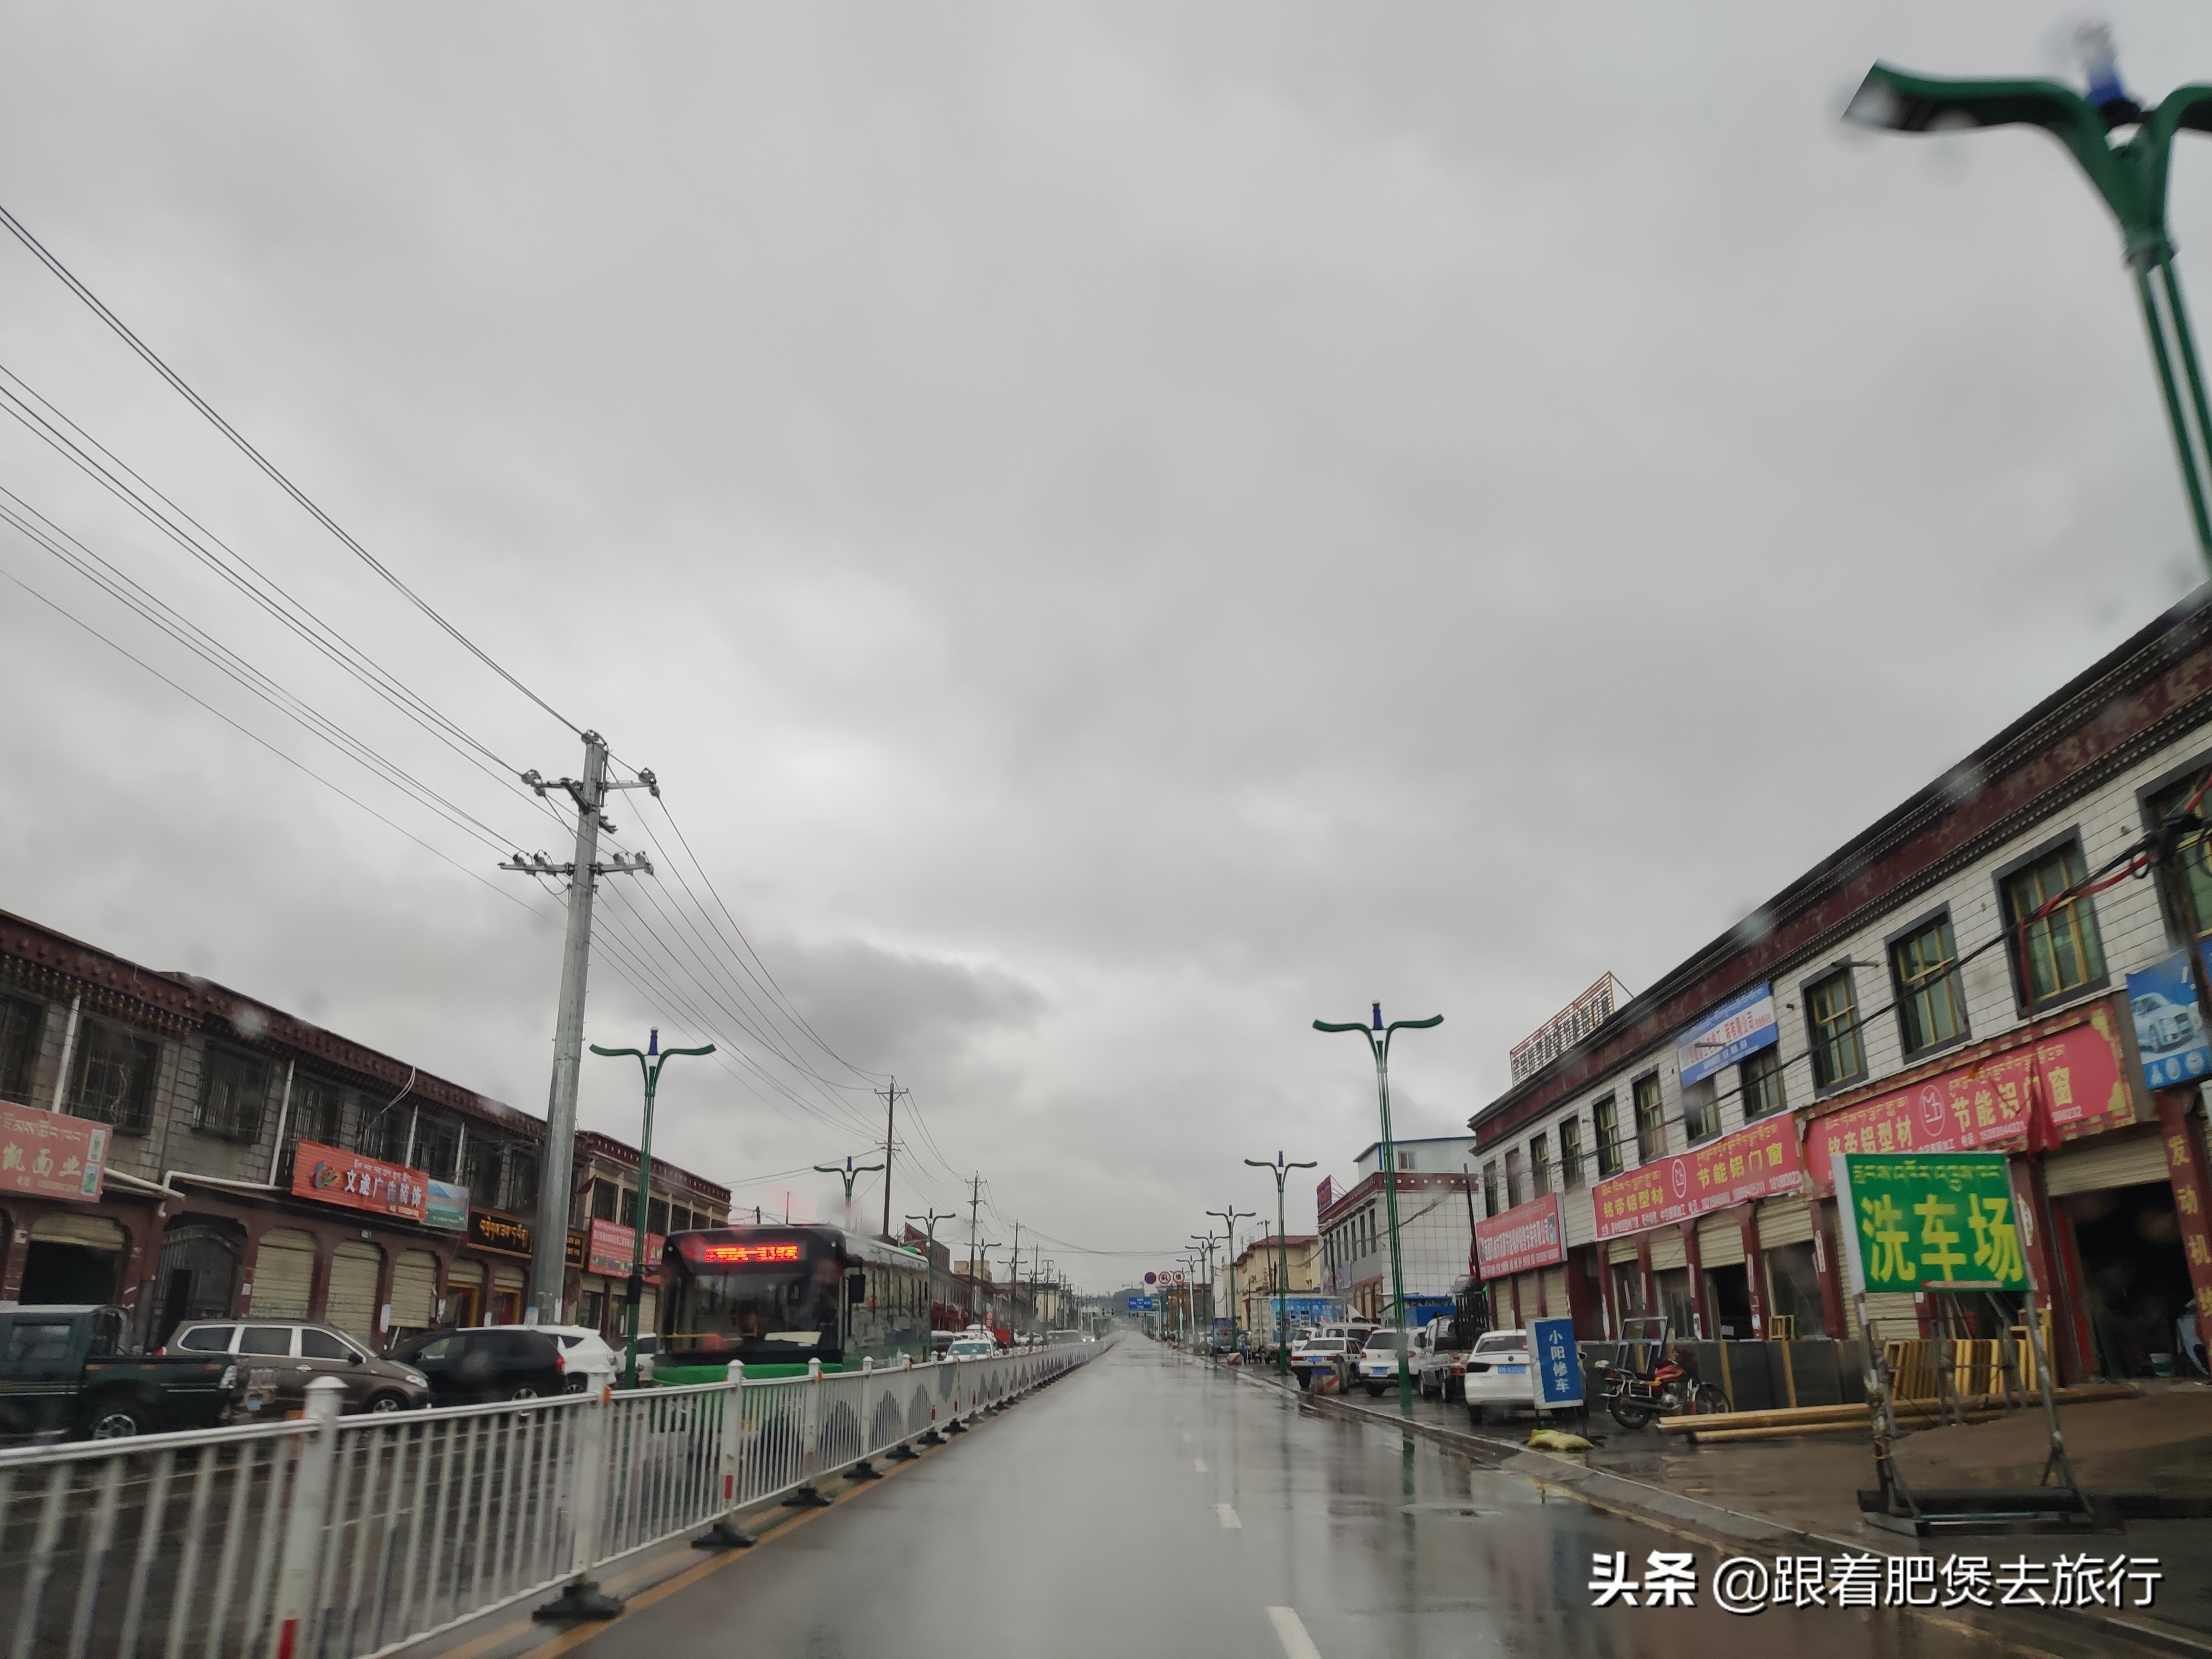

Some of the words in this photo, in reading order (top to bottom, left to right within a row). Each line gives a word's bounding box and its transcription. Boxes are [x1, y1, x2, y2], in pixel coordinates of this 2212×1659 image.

[1951, 1066, 2073, 1133] 节能铝门窗
[1697, 1142, 1783, 1189] 节能铝门窗
[1861, 1193, 2024, 1282] 洗车场
[1549, 1329, 1571, 1392] 小阳修车
